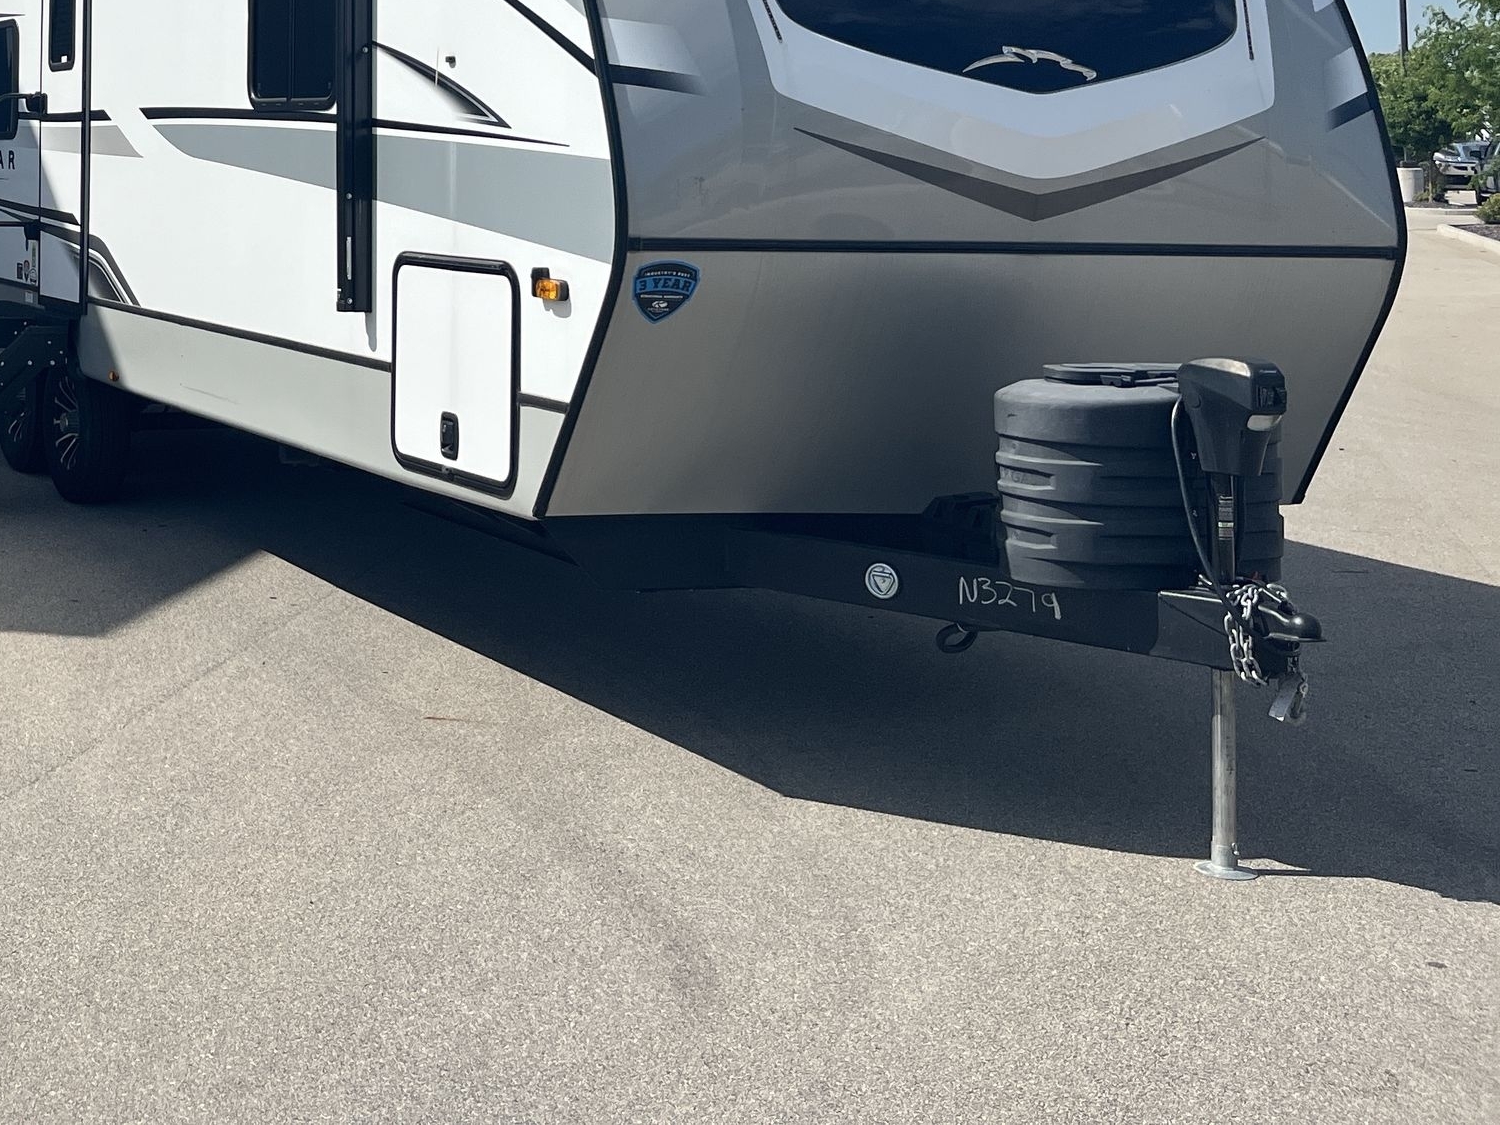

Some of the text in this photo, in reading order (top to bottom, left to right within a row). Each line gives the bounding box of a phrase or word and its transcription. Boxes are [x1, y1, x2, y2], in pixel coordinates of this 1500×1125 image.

[638, 277, 692, 293] 3 YEAR
[959, 576, 1062, 620] N3279
